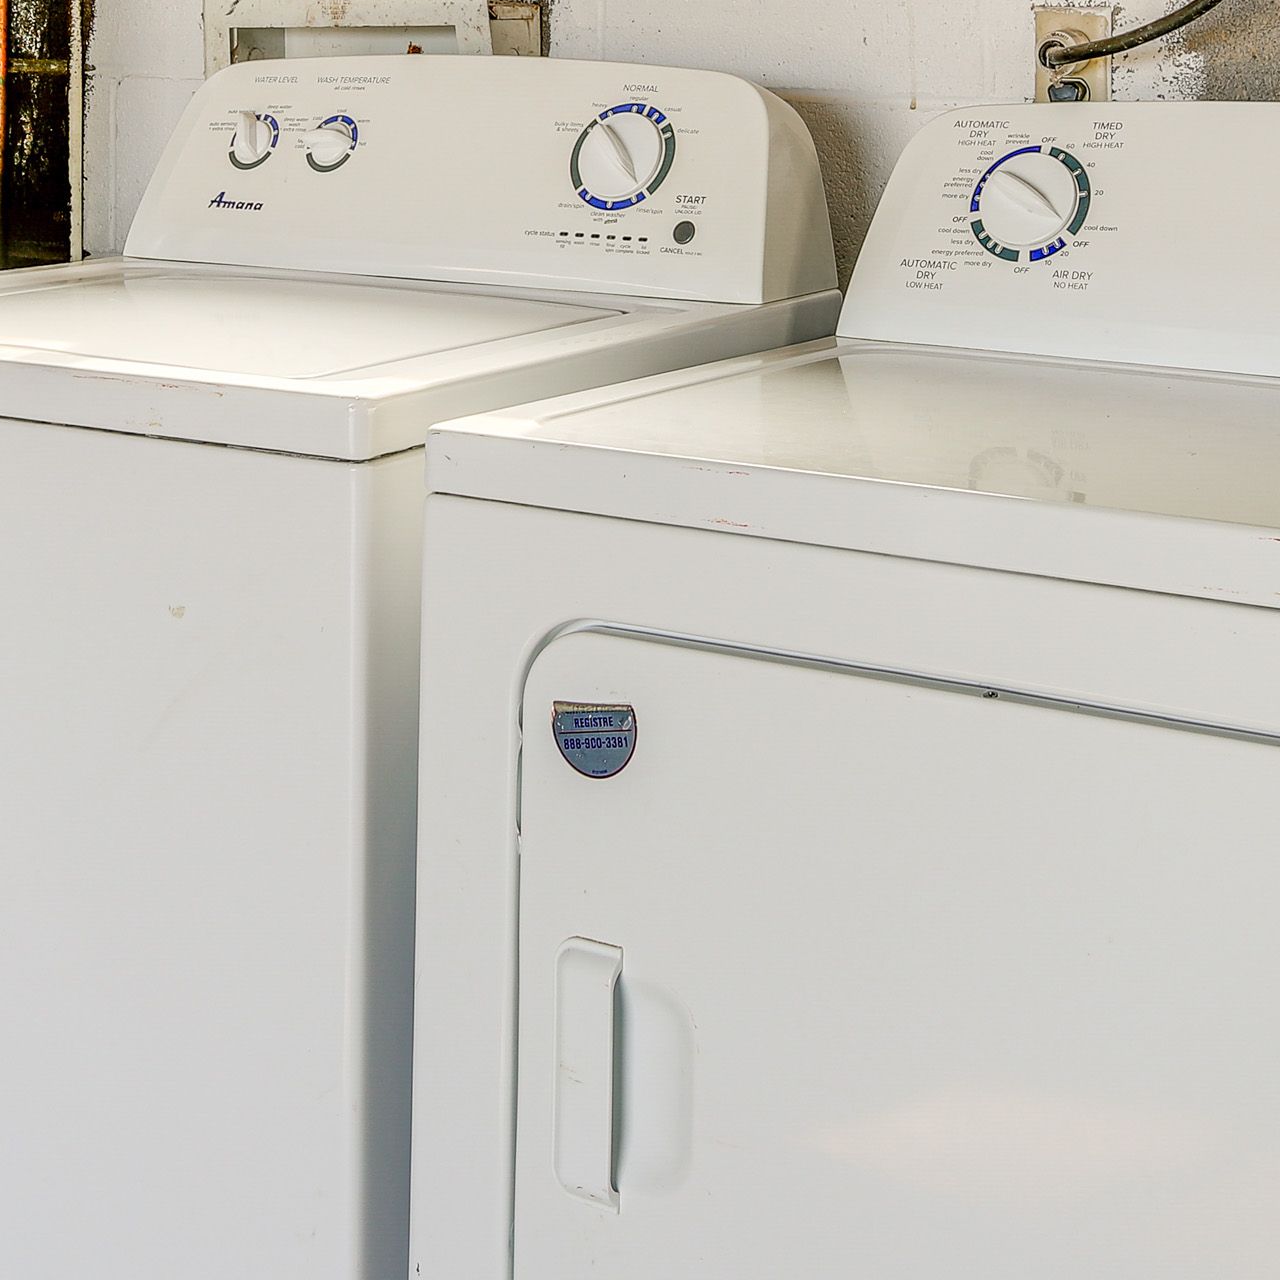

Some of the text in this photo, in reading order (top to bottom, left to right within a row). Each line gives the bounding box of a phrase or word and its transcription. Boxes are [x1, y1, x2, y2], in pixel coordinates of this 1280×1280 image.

[623, 84, 659, 93] NORMAL
[954, 121, 1010, 129] AUTOMATIC
[1093, 122, 1123, 130] TIMED
[1095, 132, 1116, 140] DRY
[208, 192, 264, 212] Amana
[676, 195, 707, 204] START
[660, 247, 684, 255] CANCEL
[900, 259, 958, 271] AUTOMATIC
[916, 271, 937, 280] DRY
[1052, 270, 1094, 280] AIR DRY
[905, 281, 923, 289] LOW
[574, 716, 614, 728] REGISTRE
[564, 736, 628, 750] 888-900-3381
